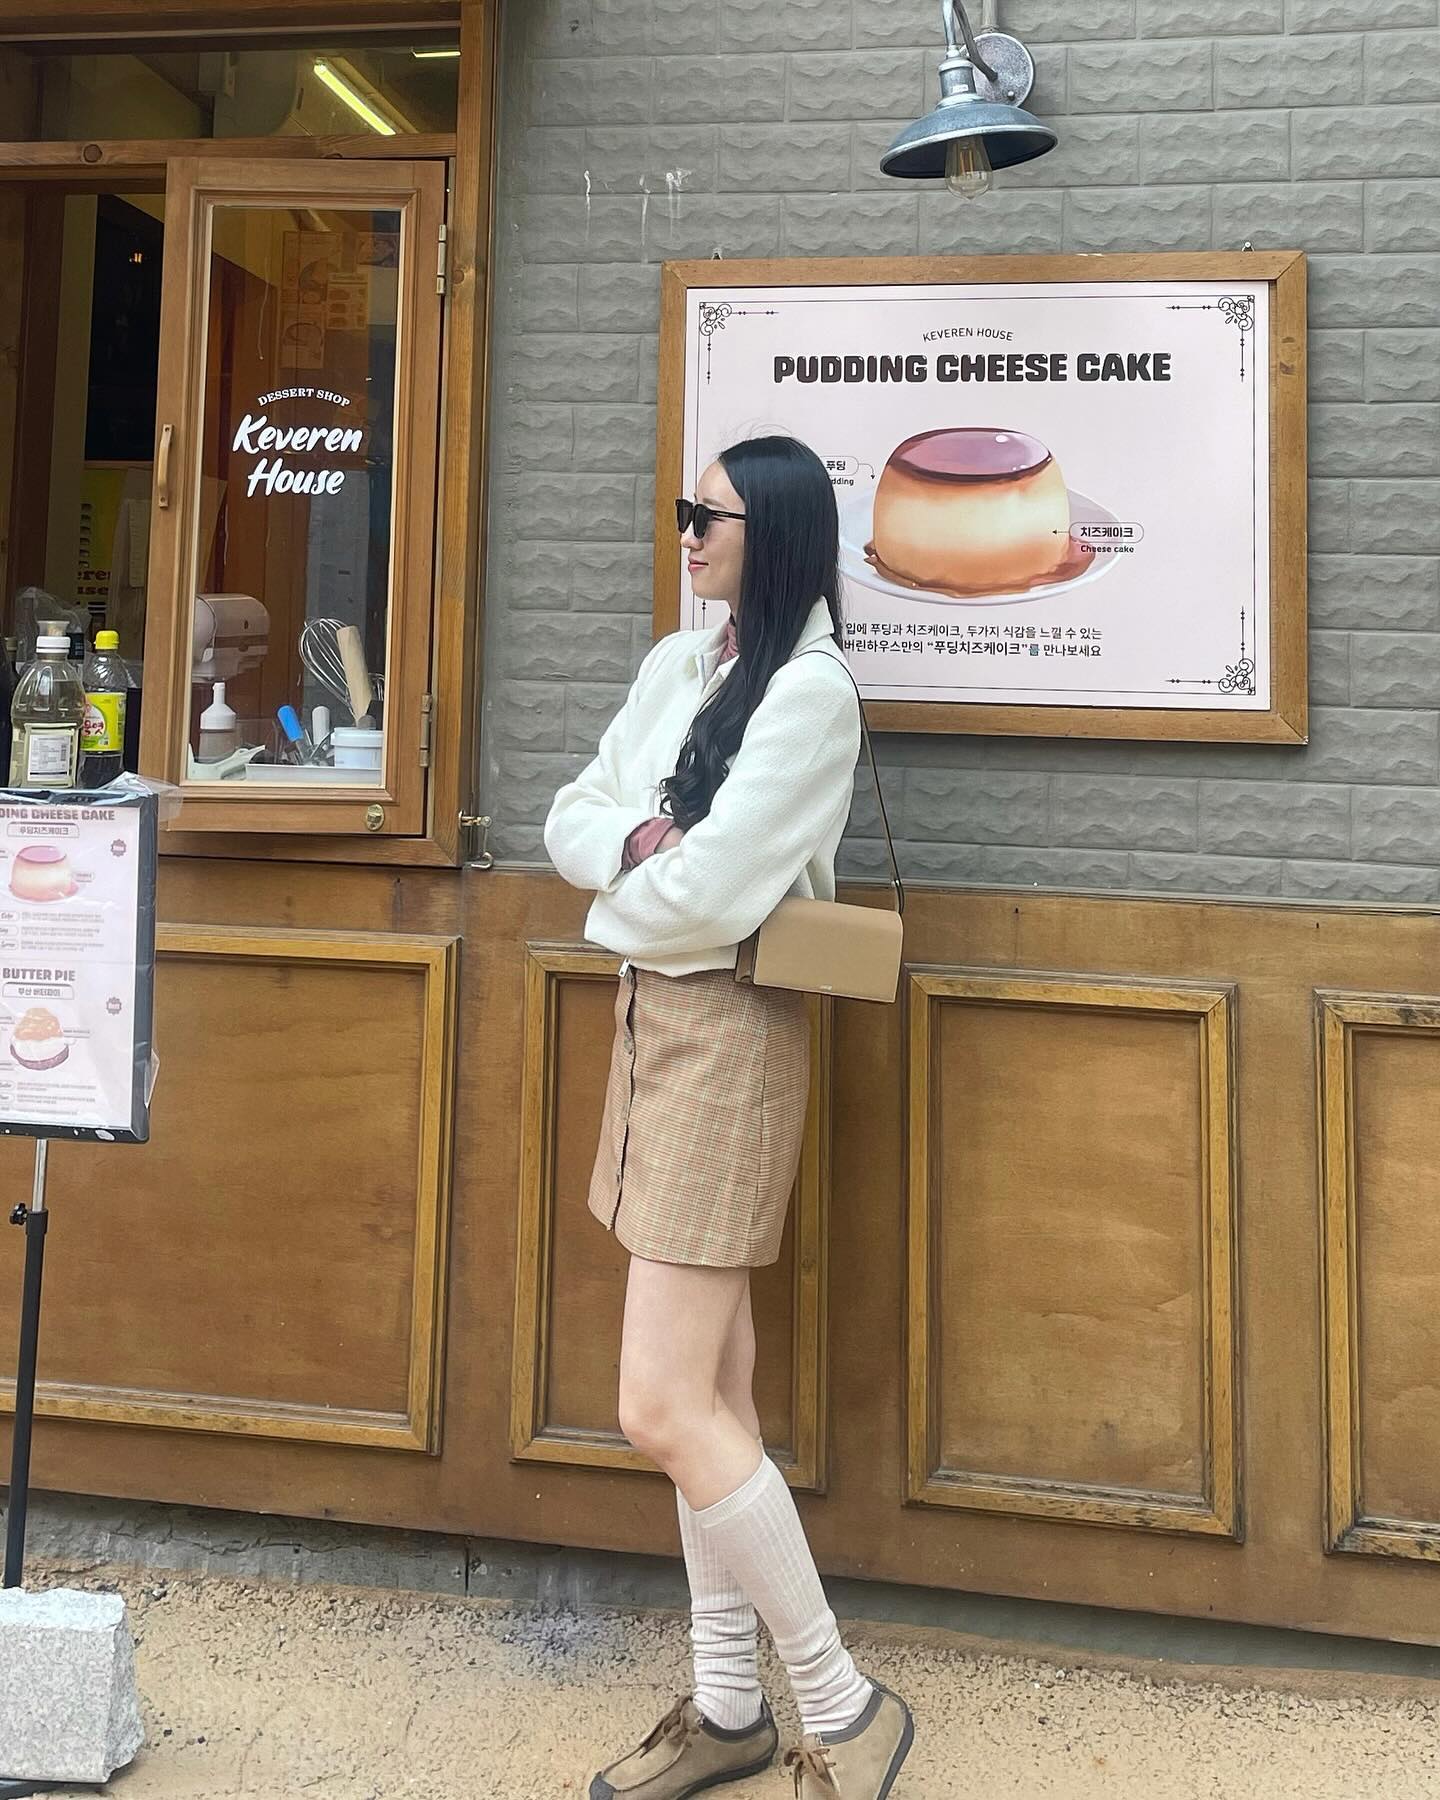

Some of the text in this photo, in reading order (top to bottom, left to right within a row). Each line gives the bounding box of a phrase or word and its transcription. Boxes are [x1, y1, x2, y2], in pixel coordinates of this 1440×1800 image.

[922, 327, 1014, 343] KEVEREN HOUSE
[774, 352, 1171, 383] PUDDING CHEESE CAKE
[257, 387, 351, 408] DESSERT SHOP
[232, 414, 363, 455] Keveren
[826, 460, 846, 471] 푸딩
[247, 457, 345, 498] House
[832, 477, 854, 486] dding
[1080, 526, 1134, 538] 치즈케이크
[1080, 545, 1135, 553] Cheese cake
[845, 623, 1103, 640] 입에 푸딩과 치즈케이크, 두가지 식감을 느낄 수 있는
[844, 639, 923, 654] 버린하우스만의
[1043, 643, 1102, 657] 만나보세요
[0, 808, 115, 821] DING CHEESE CAKE
[2, 967, 76, 982] BUTTER PIE
